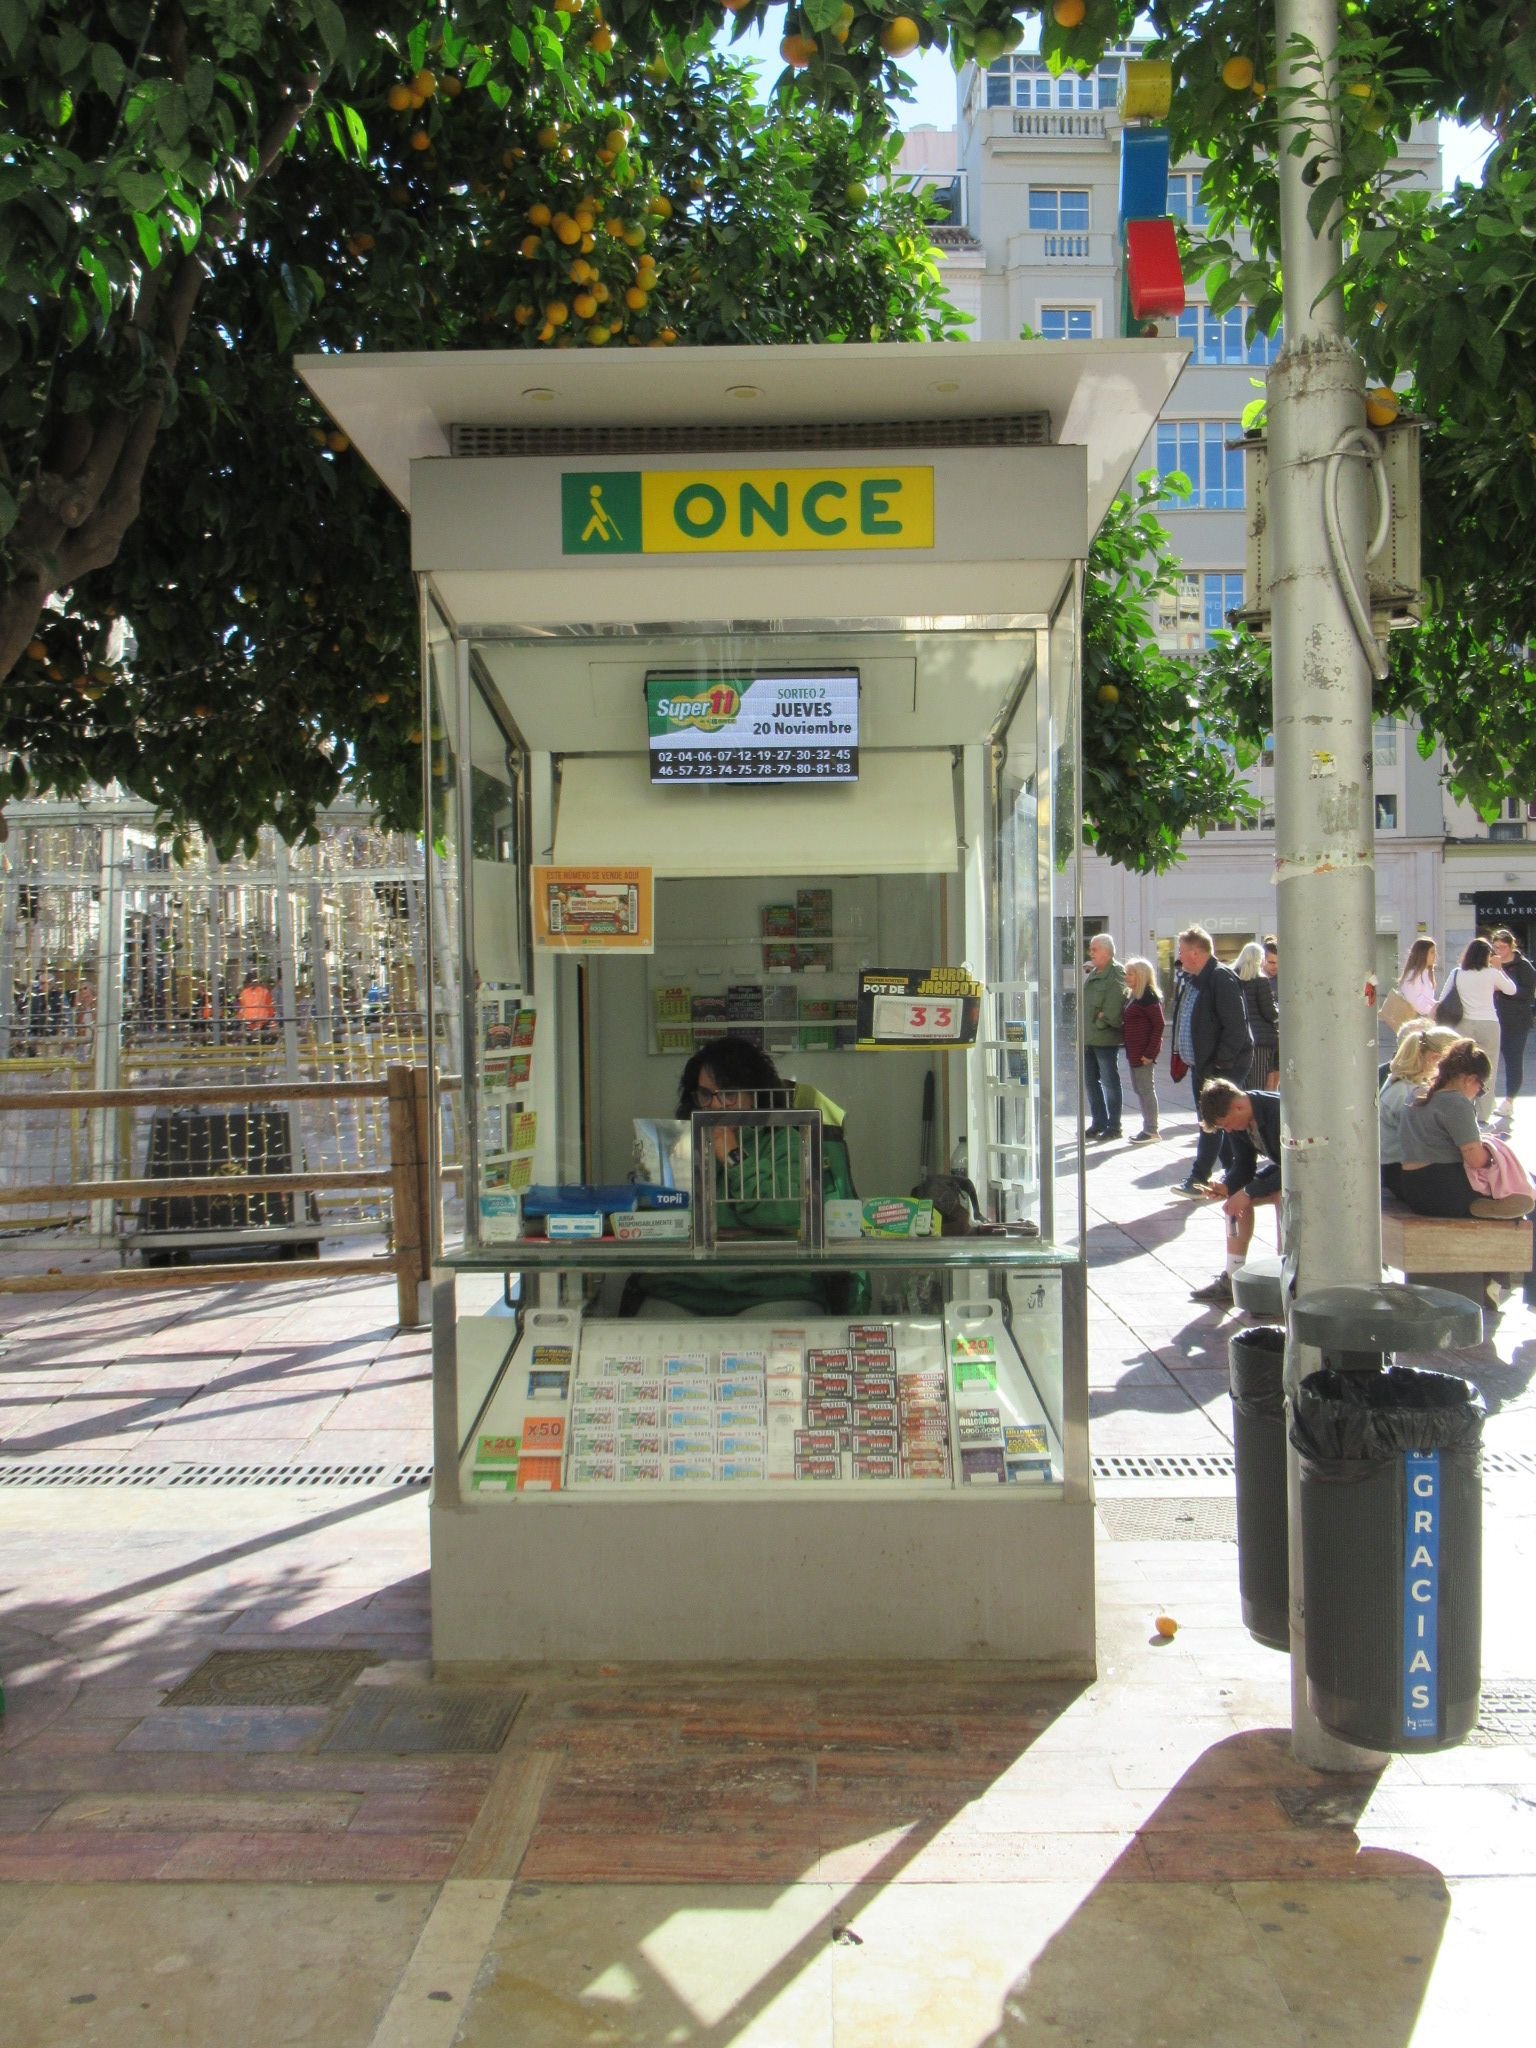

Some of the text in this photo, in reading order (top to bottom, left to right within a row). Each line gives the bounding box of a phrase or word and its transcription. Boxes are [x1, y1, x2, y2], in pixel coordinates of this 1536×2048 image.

[674, 479, 903, 538] ONCE
[778, 688, 826, 699] SORTEO 2
[657, 690, 735, 720] Super 11
[772, 702, 832, 718] JUEVES
[753, 720, 852, 735] 20 Noviembre
[602, 871, 622, 879] VENDE
[863, 984, 905, 995] POT DE
[918, 981, 979, 996] JACKPOT
[528, 1422, 561, 1436] x50
[1409, 1474, 1434, 1709] GRACIAS
